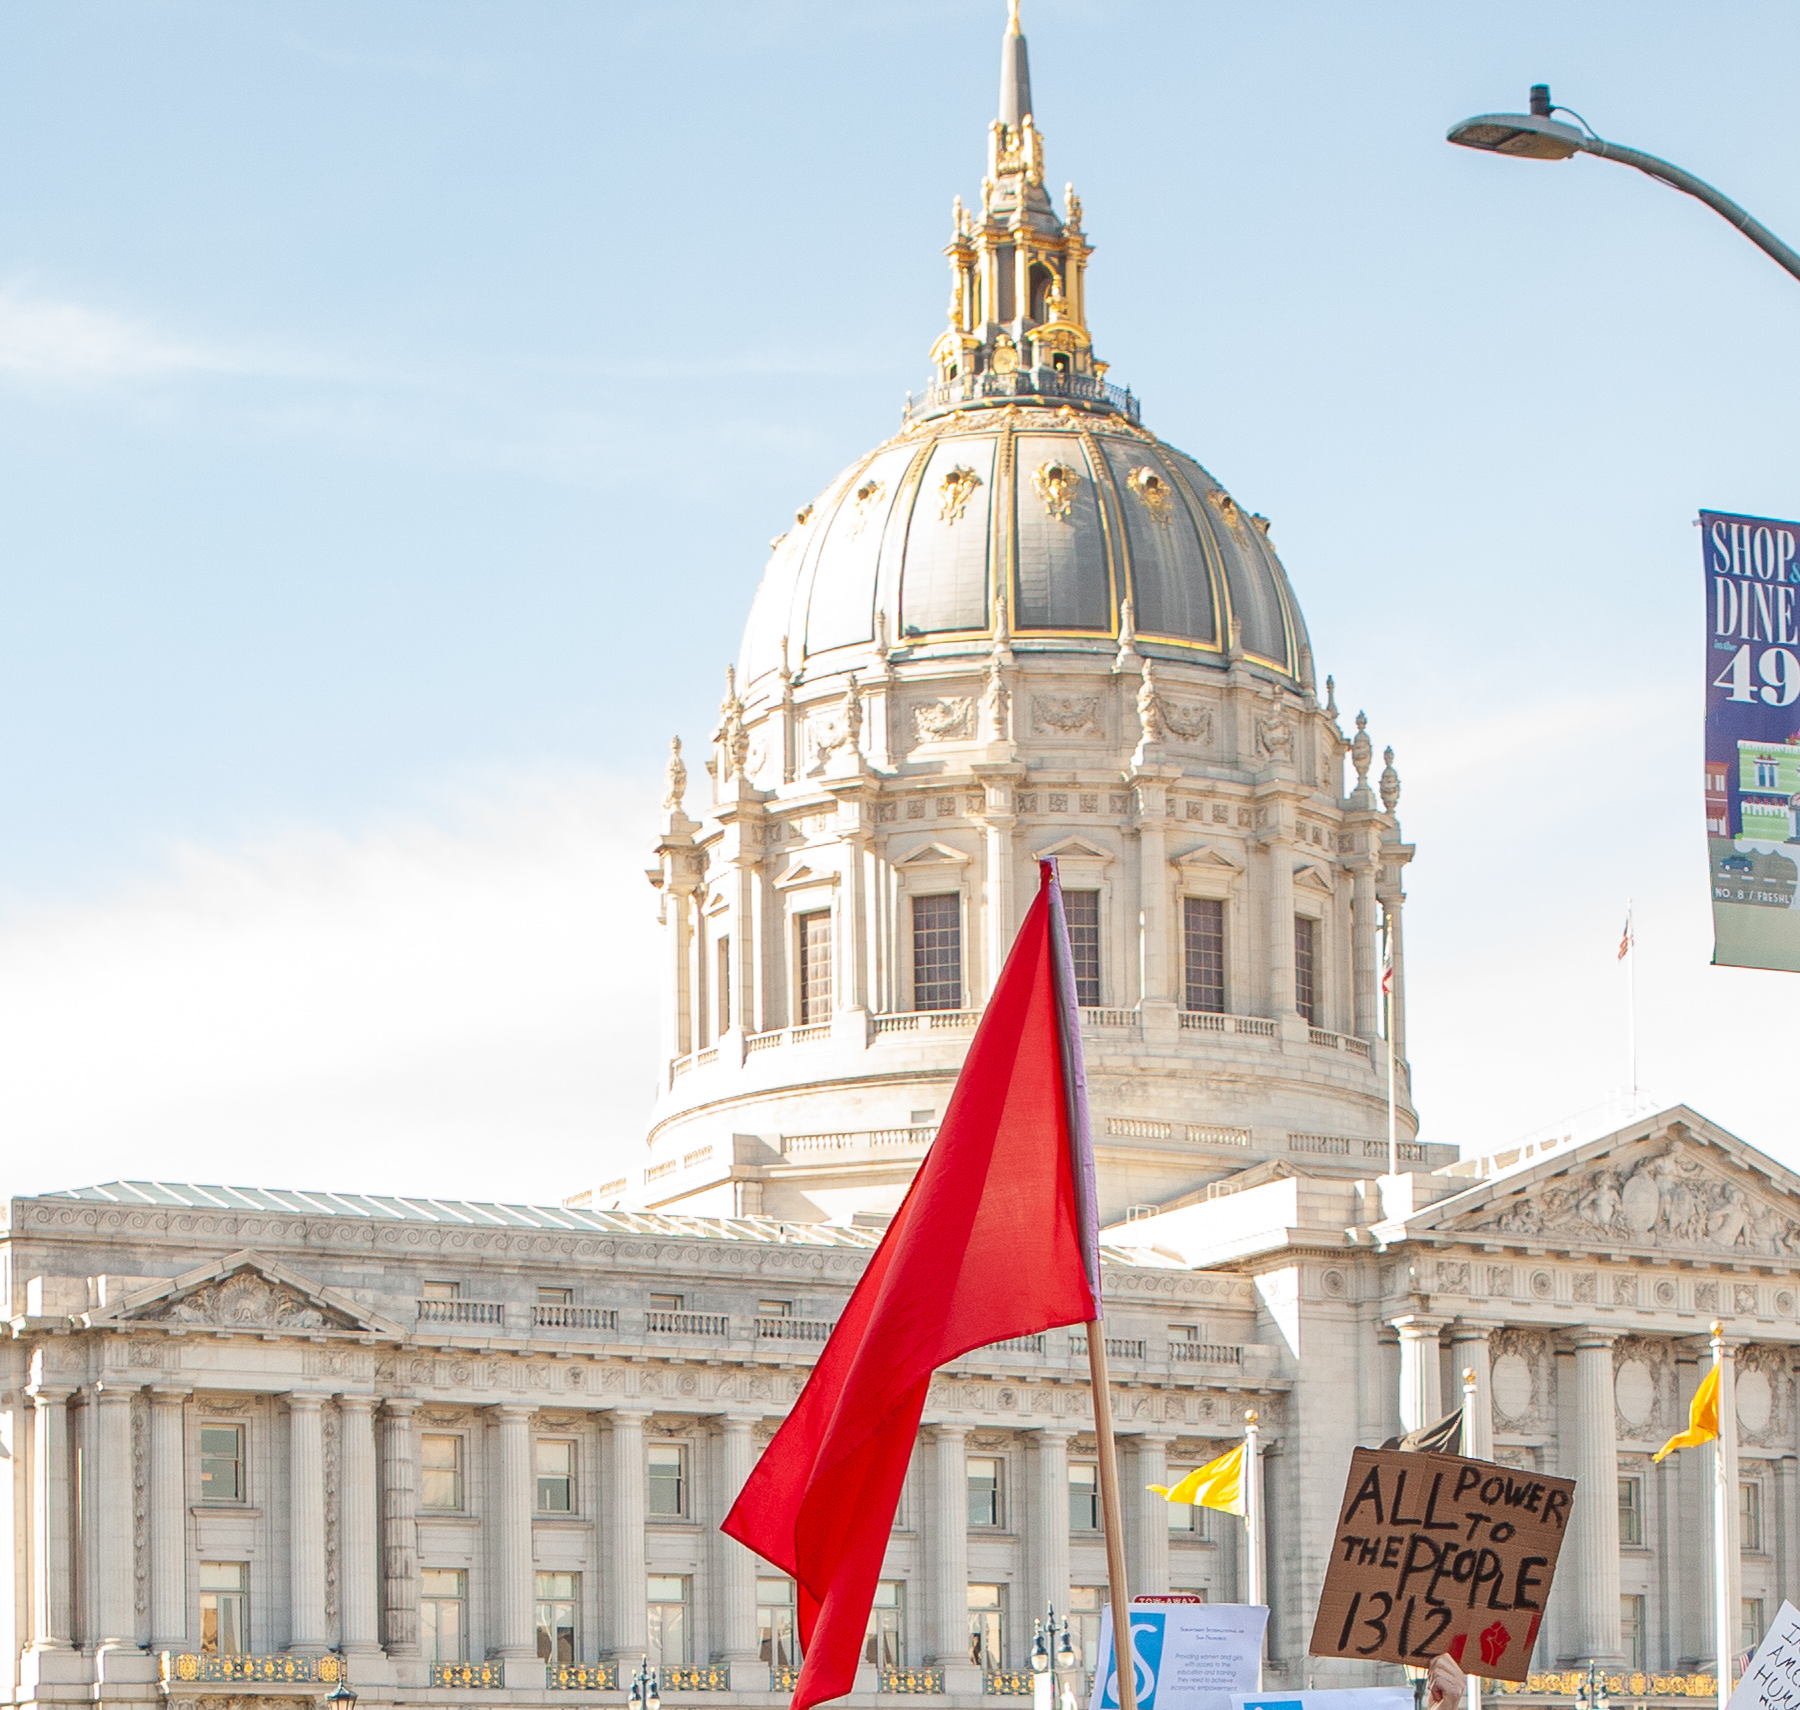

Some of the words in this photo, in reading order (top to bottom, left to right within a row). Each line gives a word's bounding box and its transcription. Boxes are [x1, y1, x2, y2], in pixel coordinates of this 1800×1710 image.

[1711, 521, 1795, 582] SHOP
[1713, 576, 1799, 645] DINE
[1737, 889, 1744, 899] 8
[1757, 892, 1794, 904] FRESHLY
[1344, 1464, 1459, 1529] ALL
[1453, 1466, 1569, 1529] POWER
[1465, 1512, 1517, 1543] TO
[1341, 1535, 1404, 1568] THE
[1396, 1533, 1549, 1610] PEOPLE
[1338, 1591, 1453, 1659] 1312
